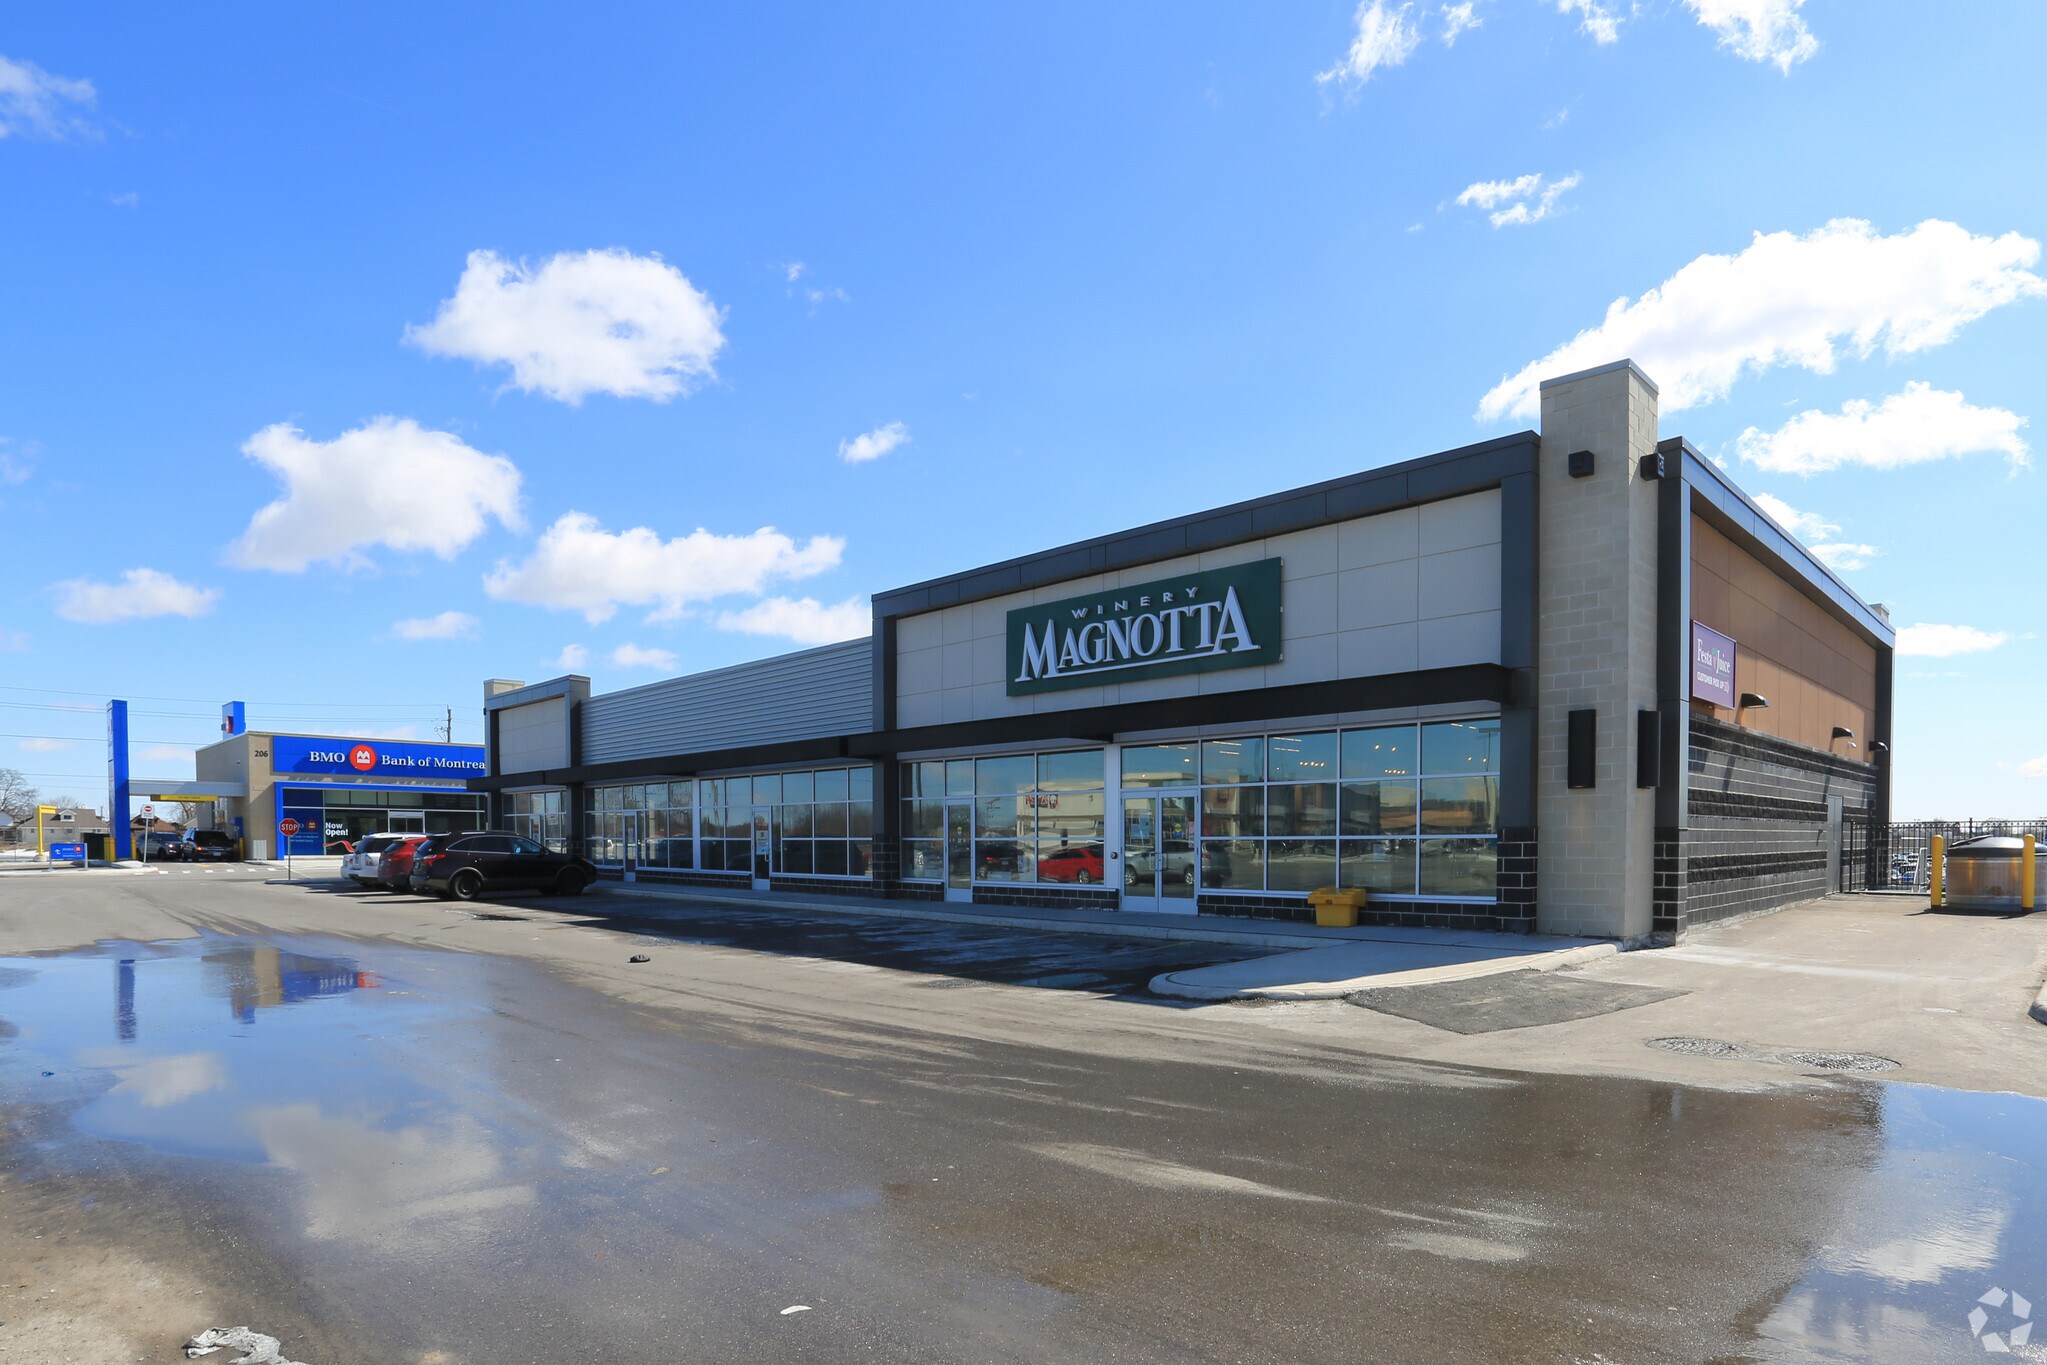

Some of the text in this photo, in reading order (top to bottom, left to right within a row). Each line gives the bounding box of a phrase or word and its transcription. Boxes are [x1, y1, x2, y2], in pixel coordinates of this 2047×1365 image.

[1071, 586, 1199, 619] WINERY
[1014, 585, 1261, 682] MAGNOTTA
[1697, 638, 1730, 674] Festa Juice
[254, 750, 268, 758] 206
[309, 751, 485, 769] BMO Bank of Montrea
[281, 823, 298, 831] STOP
[325, 829, 348, 837] Open!
